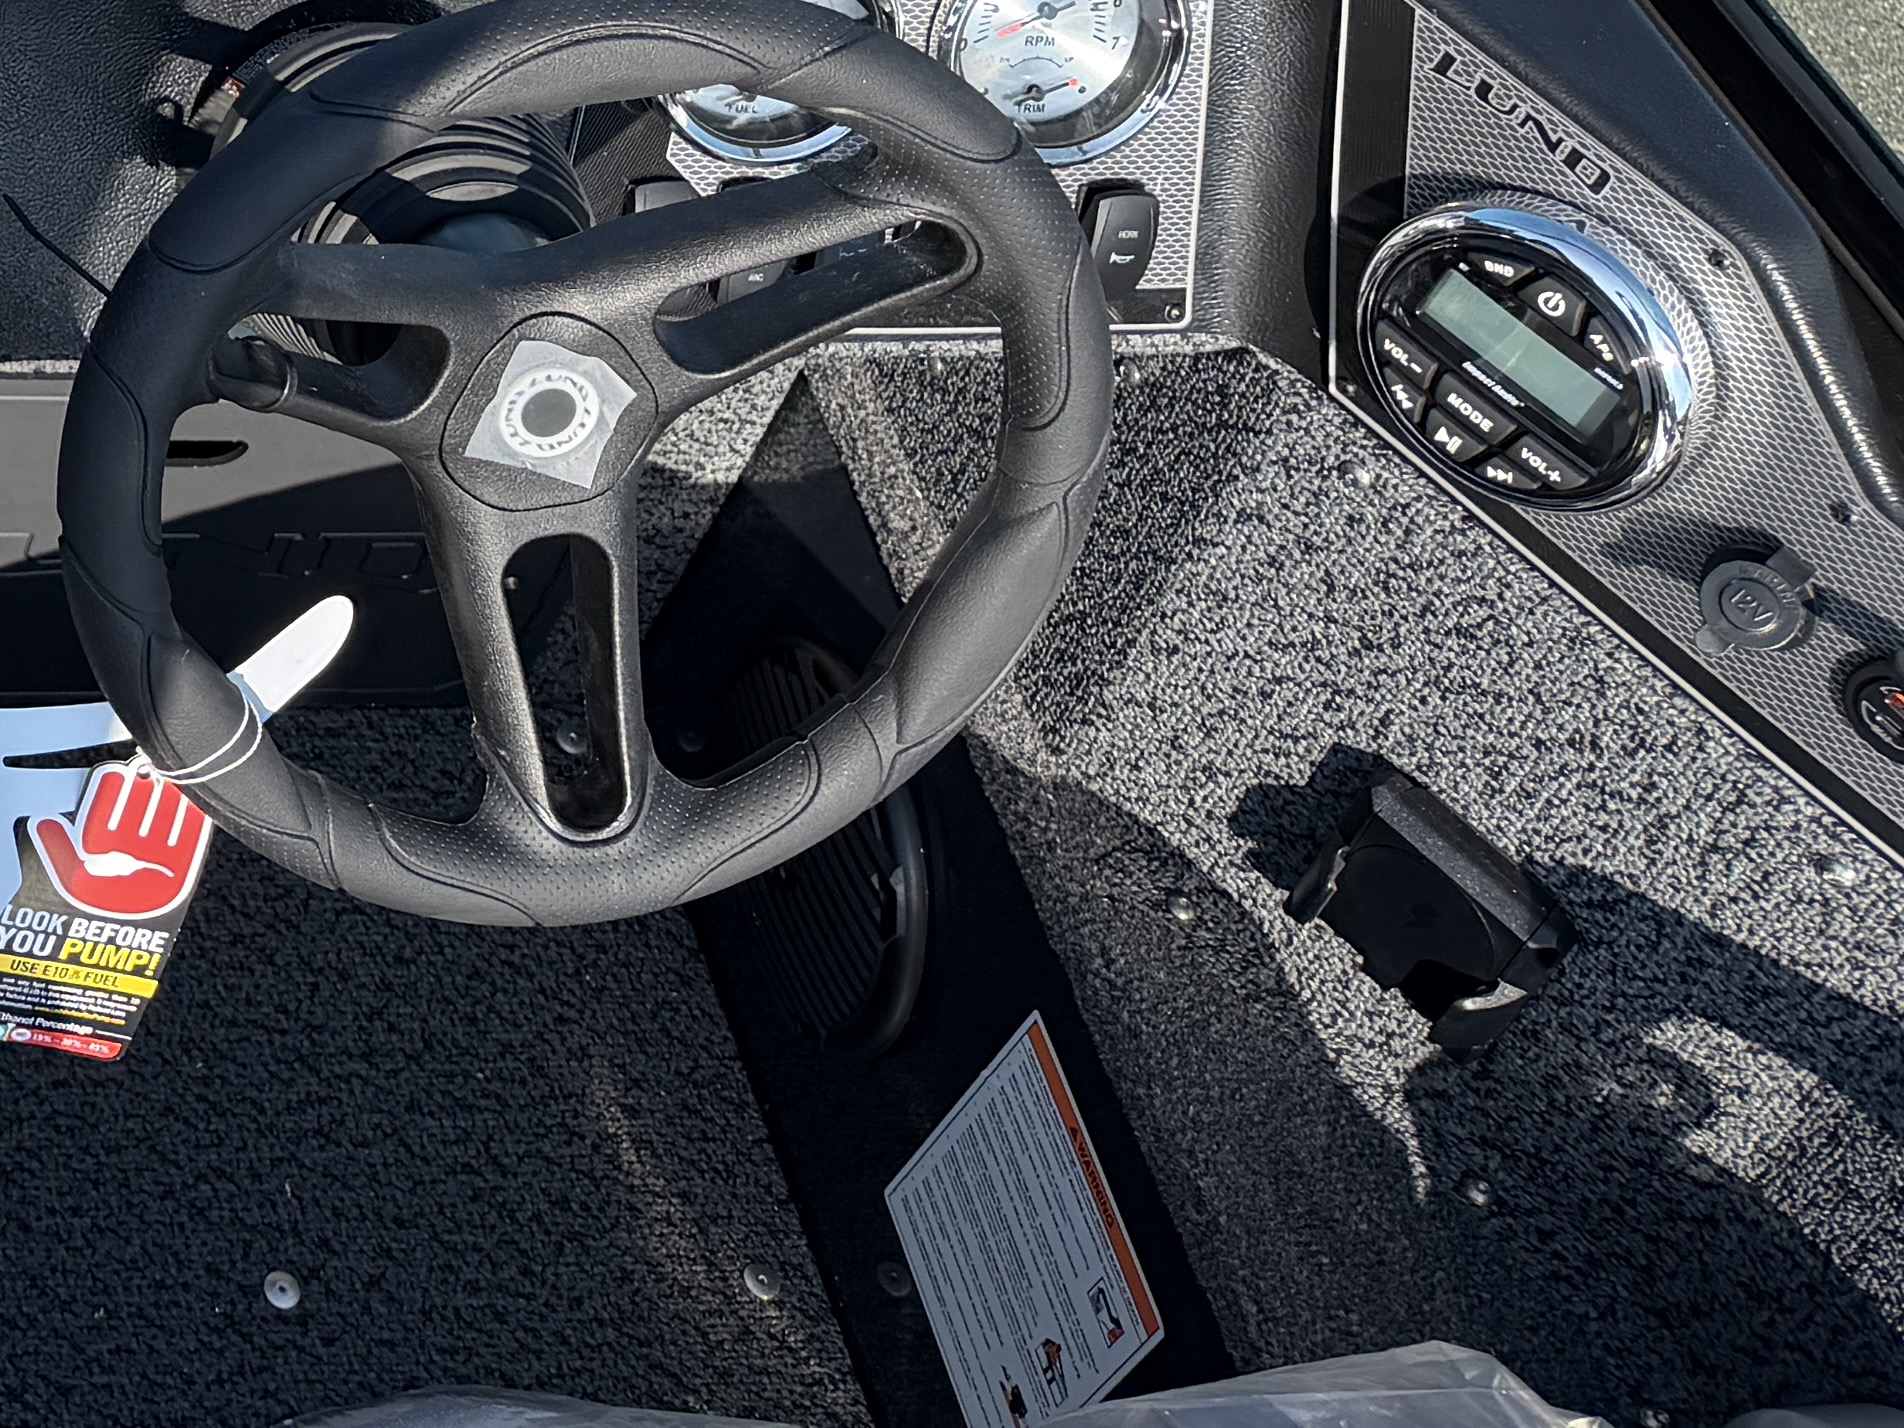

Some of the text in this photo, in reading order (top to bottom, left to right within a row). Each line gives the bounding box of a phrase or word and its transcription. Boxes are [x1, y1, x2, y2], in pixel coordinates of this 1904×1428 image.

[1024, 35, 1055, 47] RPM
[1015, 102, 1046, 114] TRIM
[1430, 51, 1611, 195] LUND
[1484, 260, 1515, 278] BND
[1589, 333, 1614, 362] APS
[1447, 392, 1494, 433] MODE
[1521, 447, 1562, 483] VOL+
[1730, 589, 1774, 623] 12V
[0, 903, 170, 953] LOOK BEFORE
[10, 959, 40, 973] USE
[43, 966, 69, 978] E10
[83, 971, 119, 987] FUEL
[58, 937, 161, 976] PUMP!
[1075, 1140, 1116, 1231] WARNING
